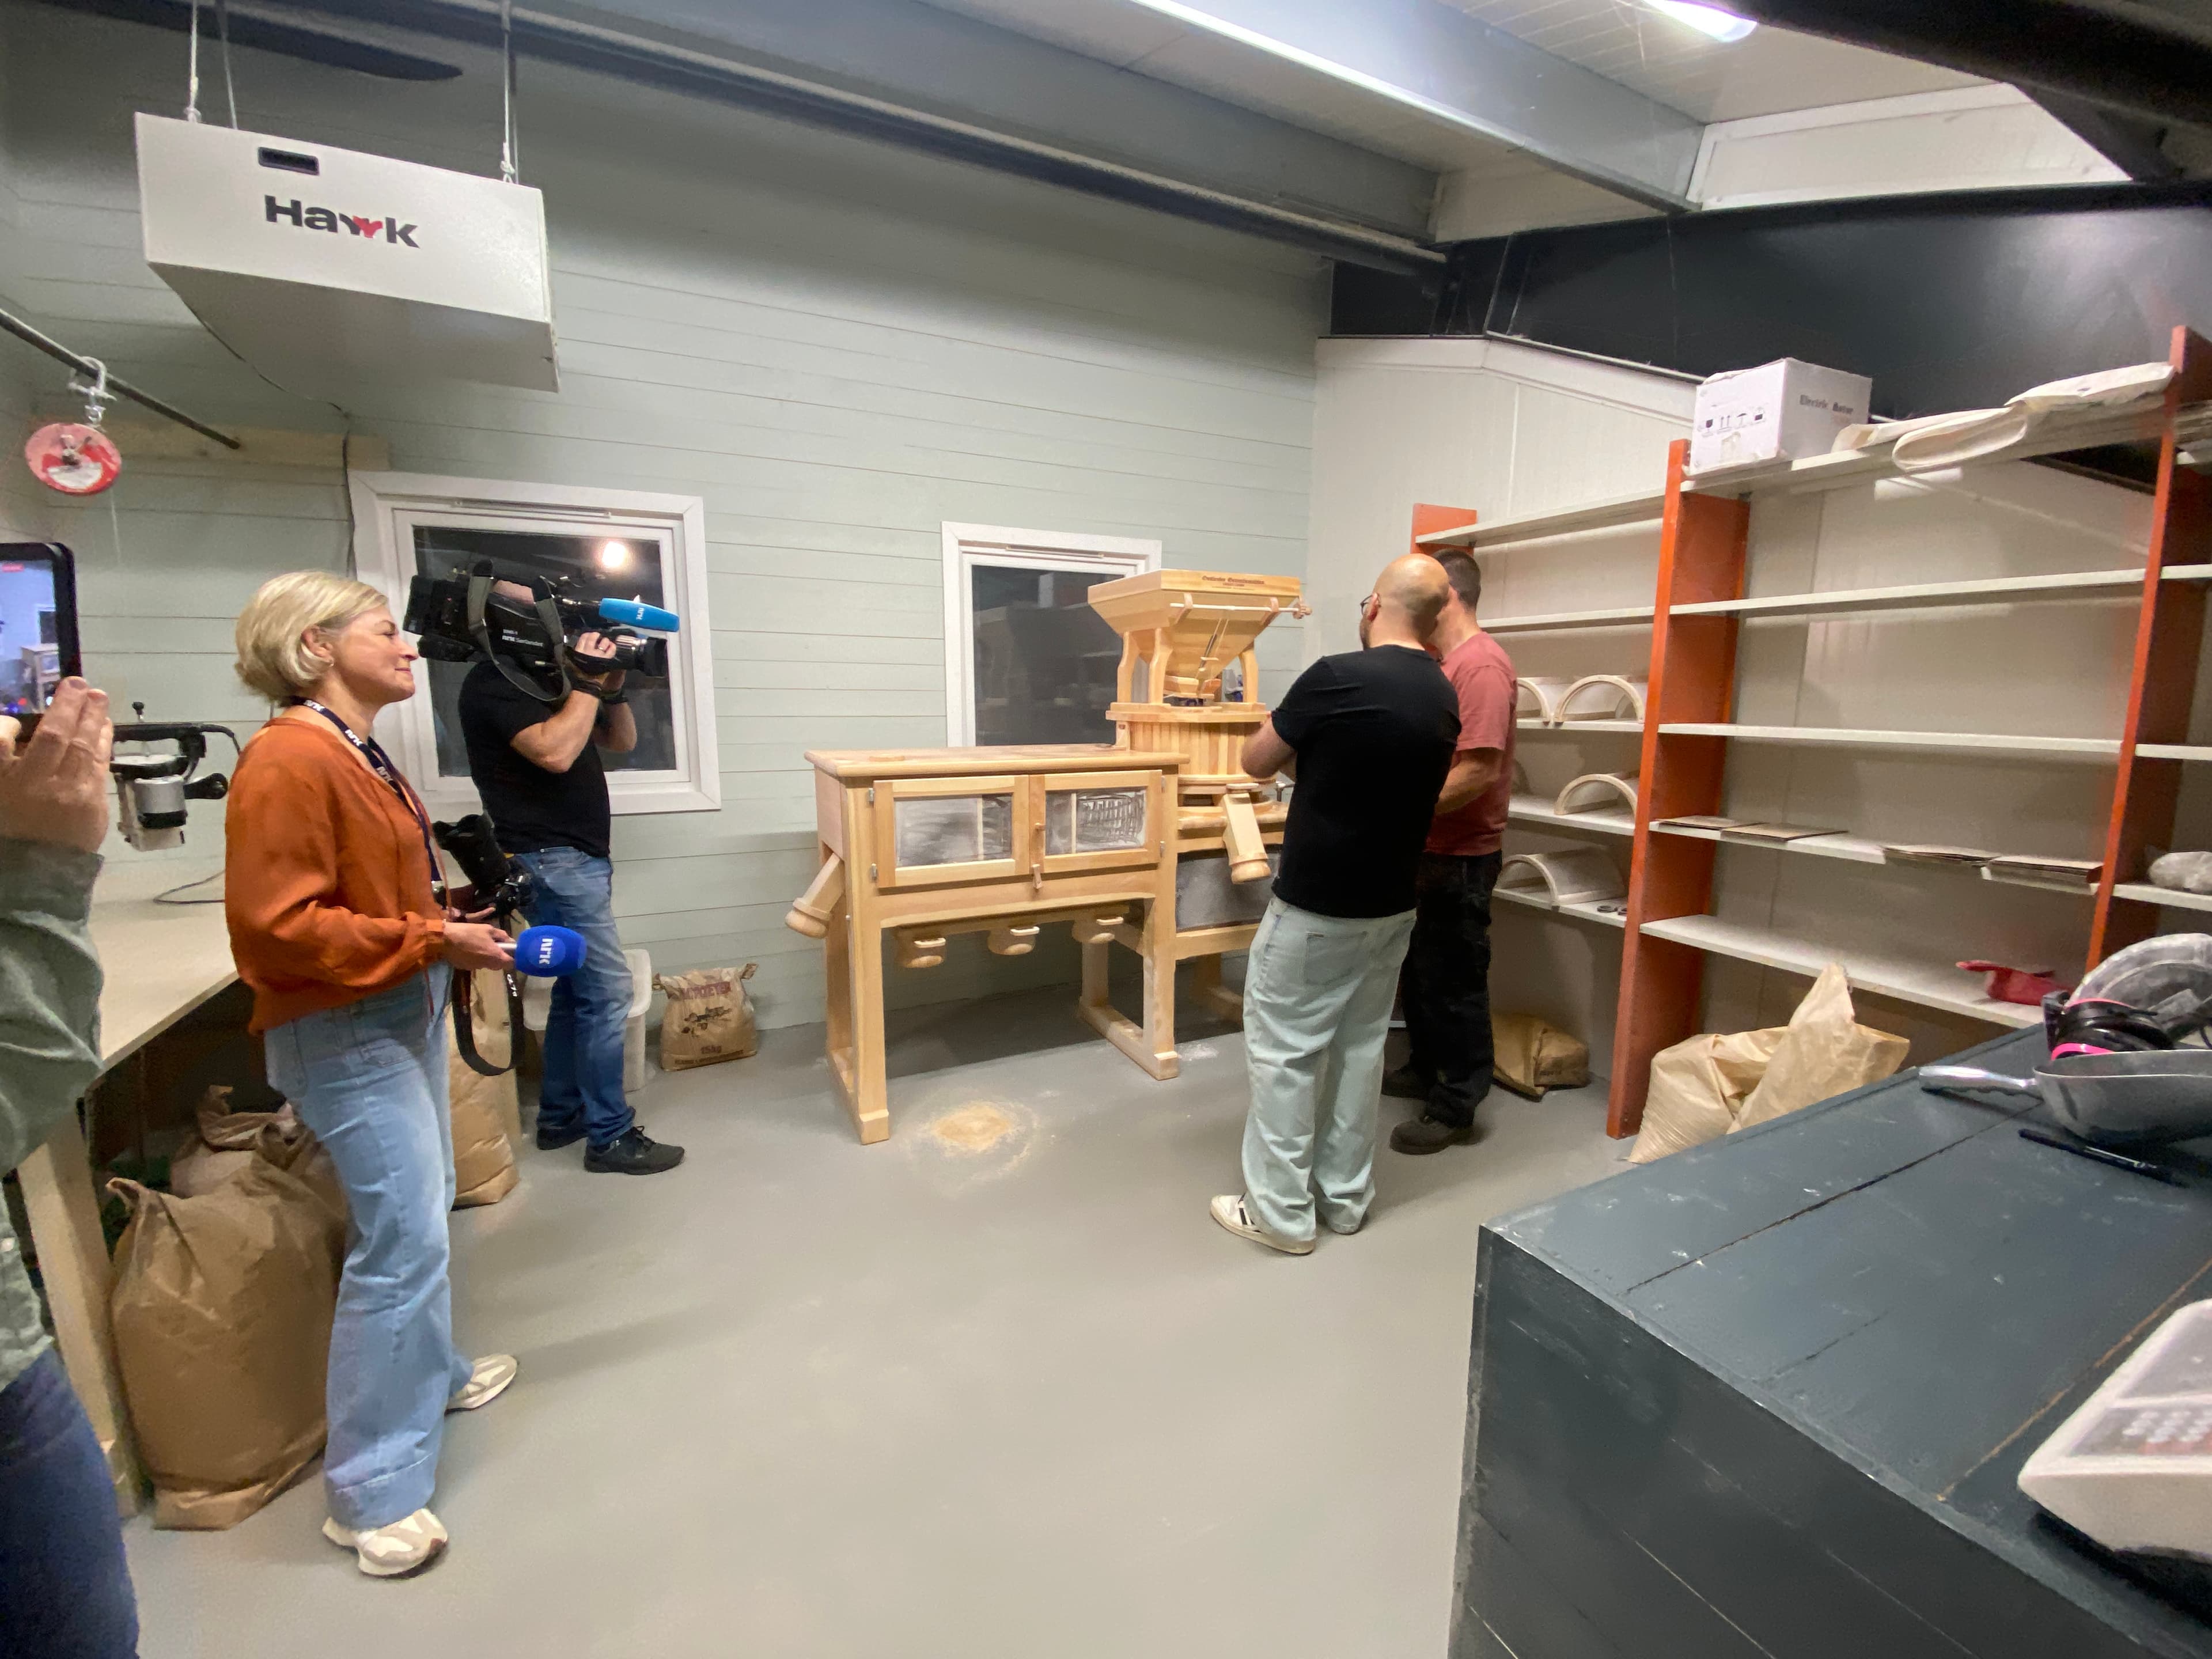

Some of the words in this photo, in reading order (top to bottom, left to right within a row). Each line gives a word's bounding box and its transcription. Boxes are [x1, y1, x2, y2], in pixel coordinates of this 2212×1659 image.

[264, 194, 420, 248] Hawk
[345, 729, 363, 746] NRK
[377, 766, 393, 782] NRK
[539, 938, 554, 964] NRK
